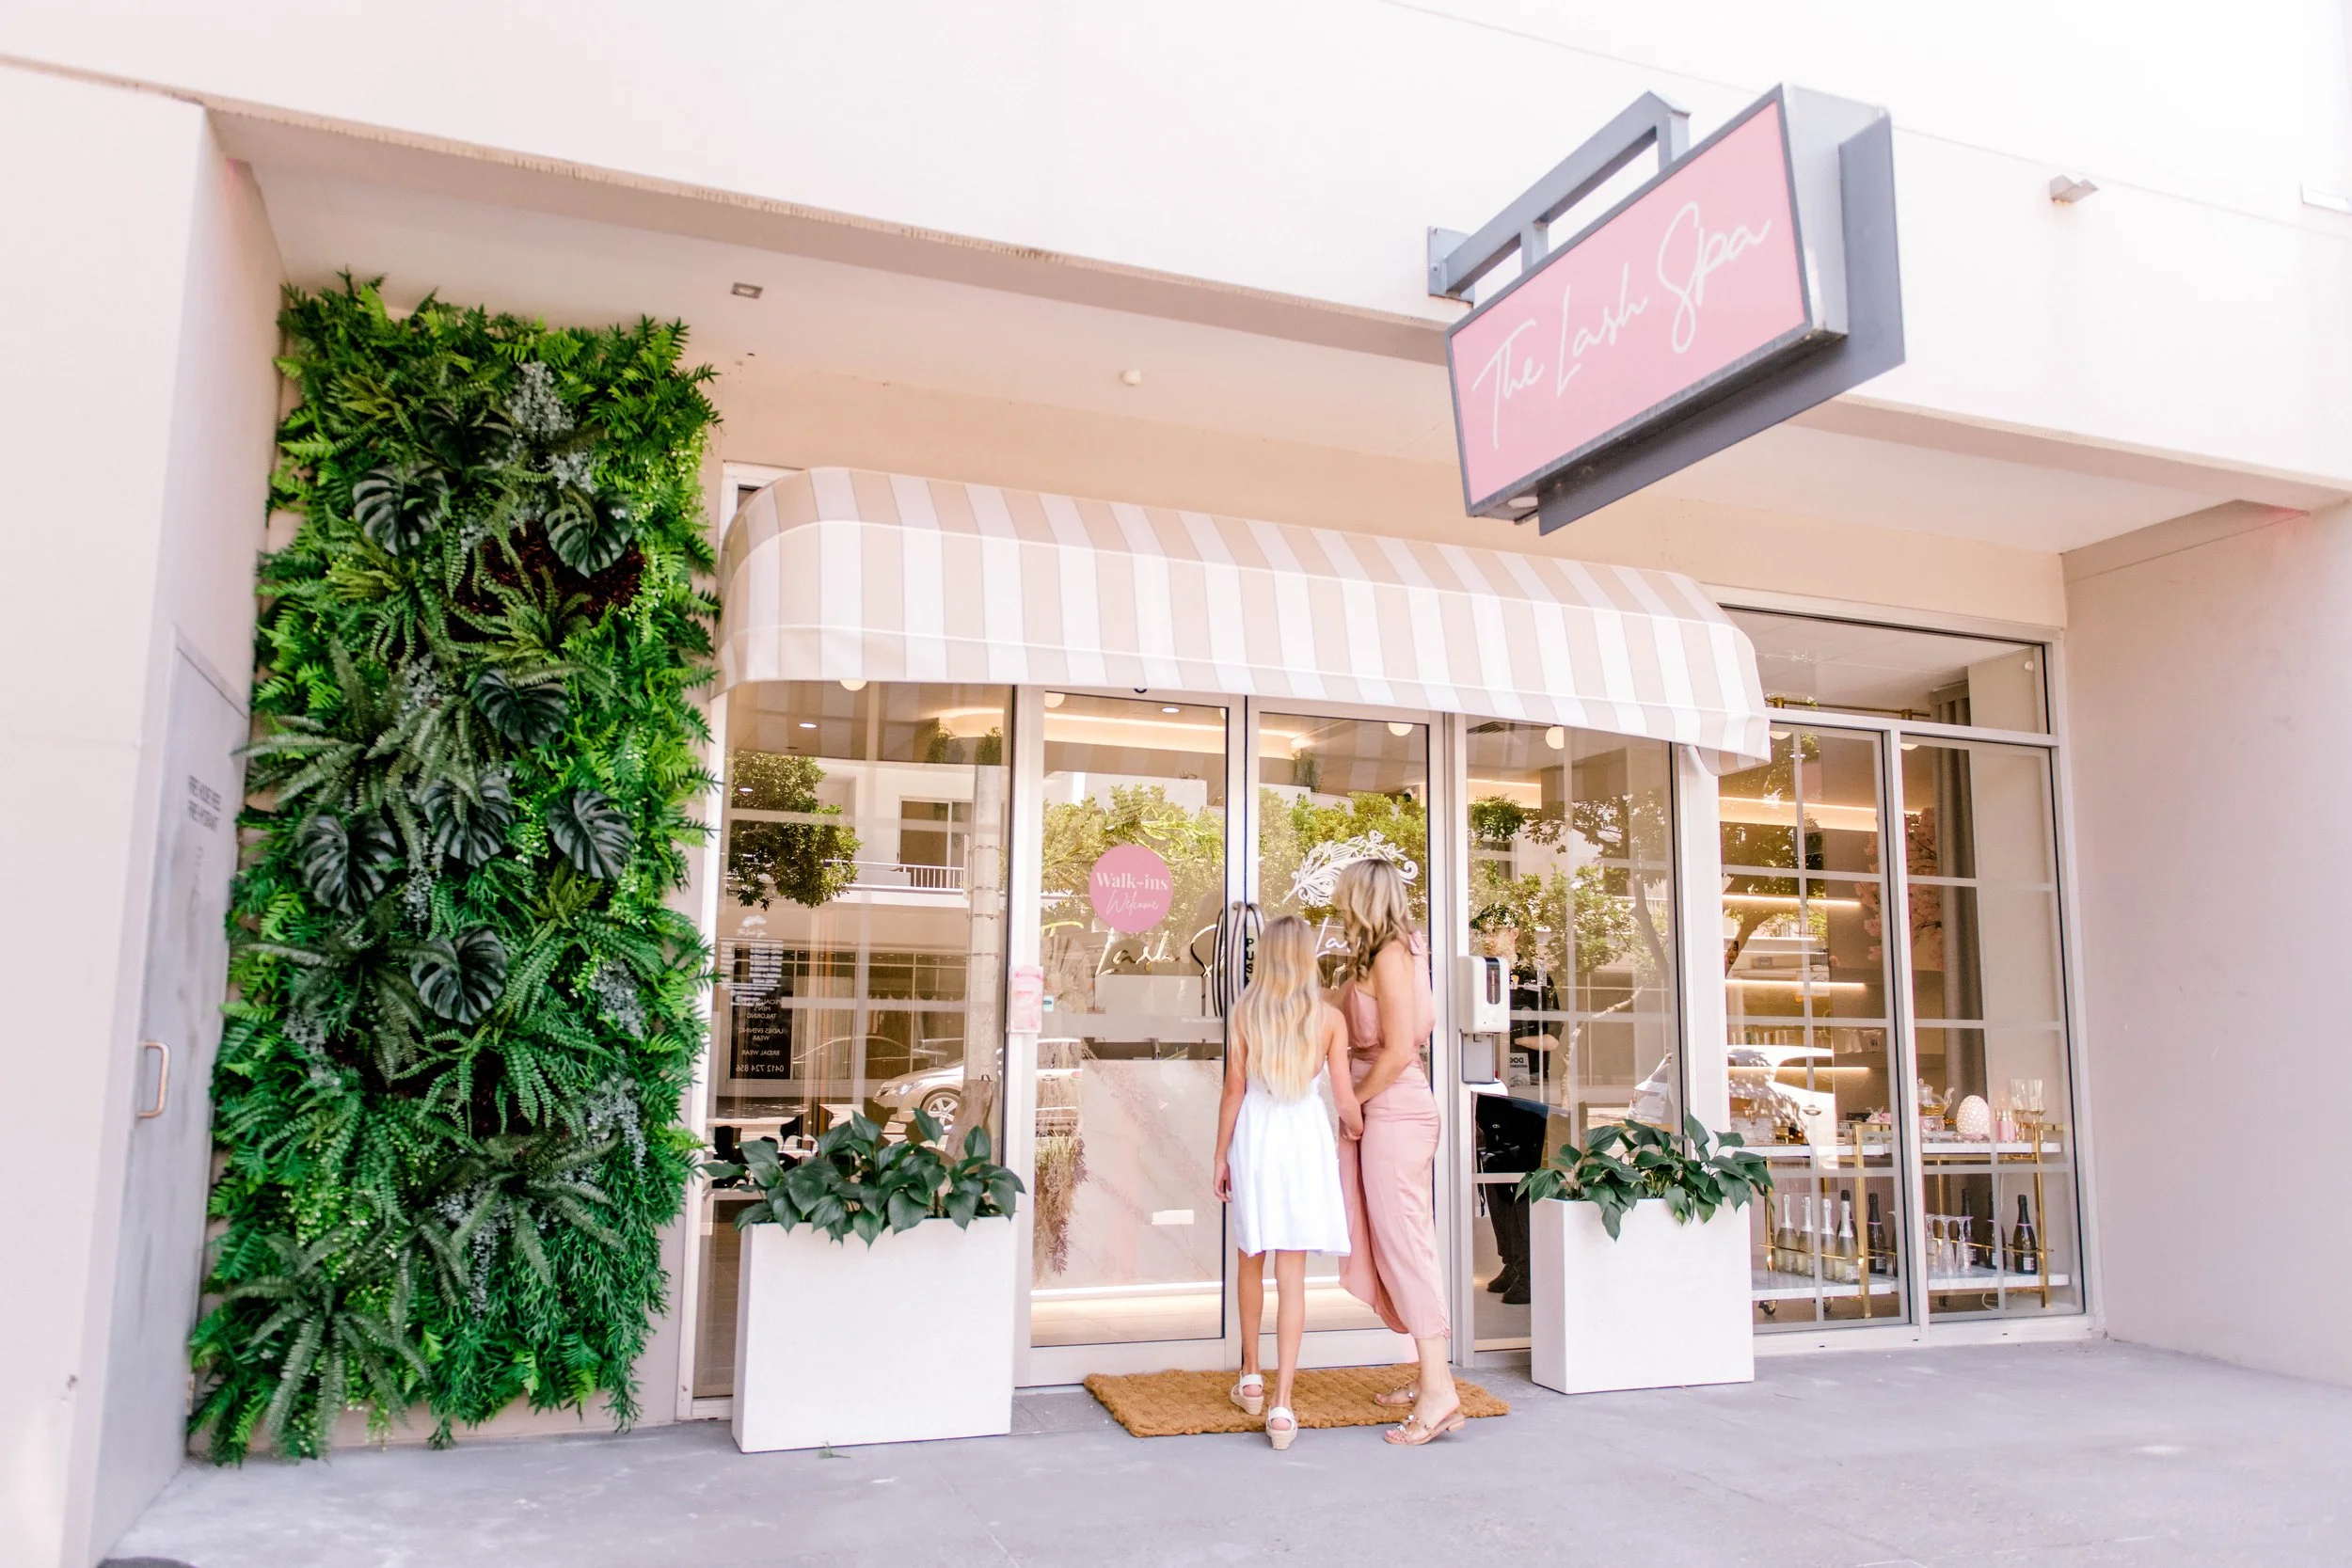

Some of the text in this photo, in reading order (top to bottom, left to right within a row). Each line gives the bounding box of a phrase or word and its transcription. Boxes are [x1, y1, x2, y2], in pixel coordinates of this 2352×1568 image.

[1470, 200, 1772, 450] The Lash Spa
[1096, 872, 1168, 891] Walk-ins
[1105, 889, 1159, 916] Welcome
